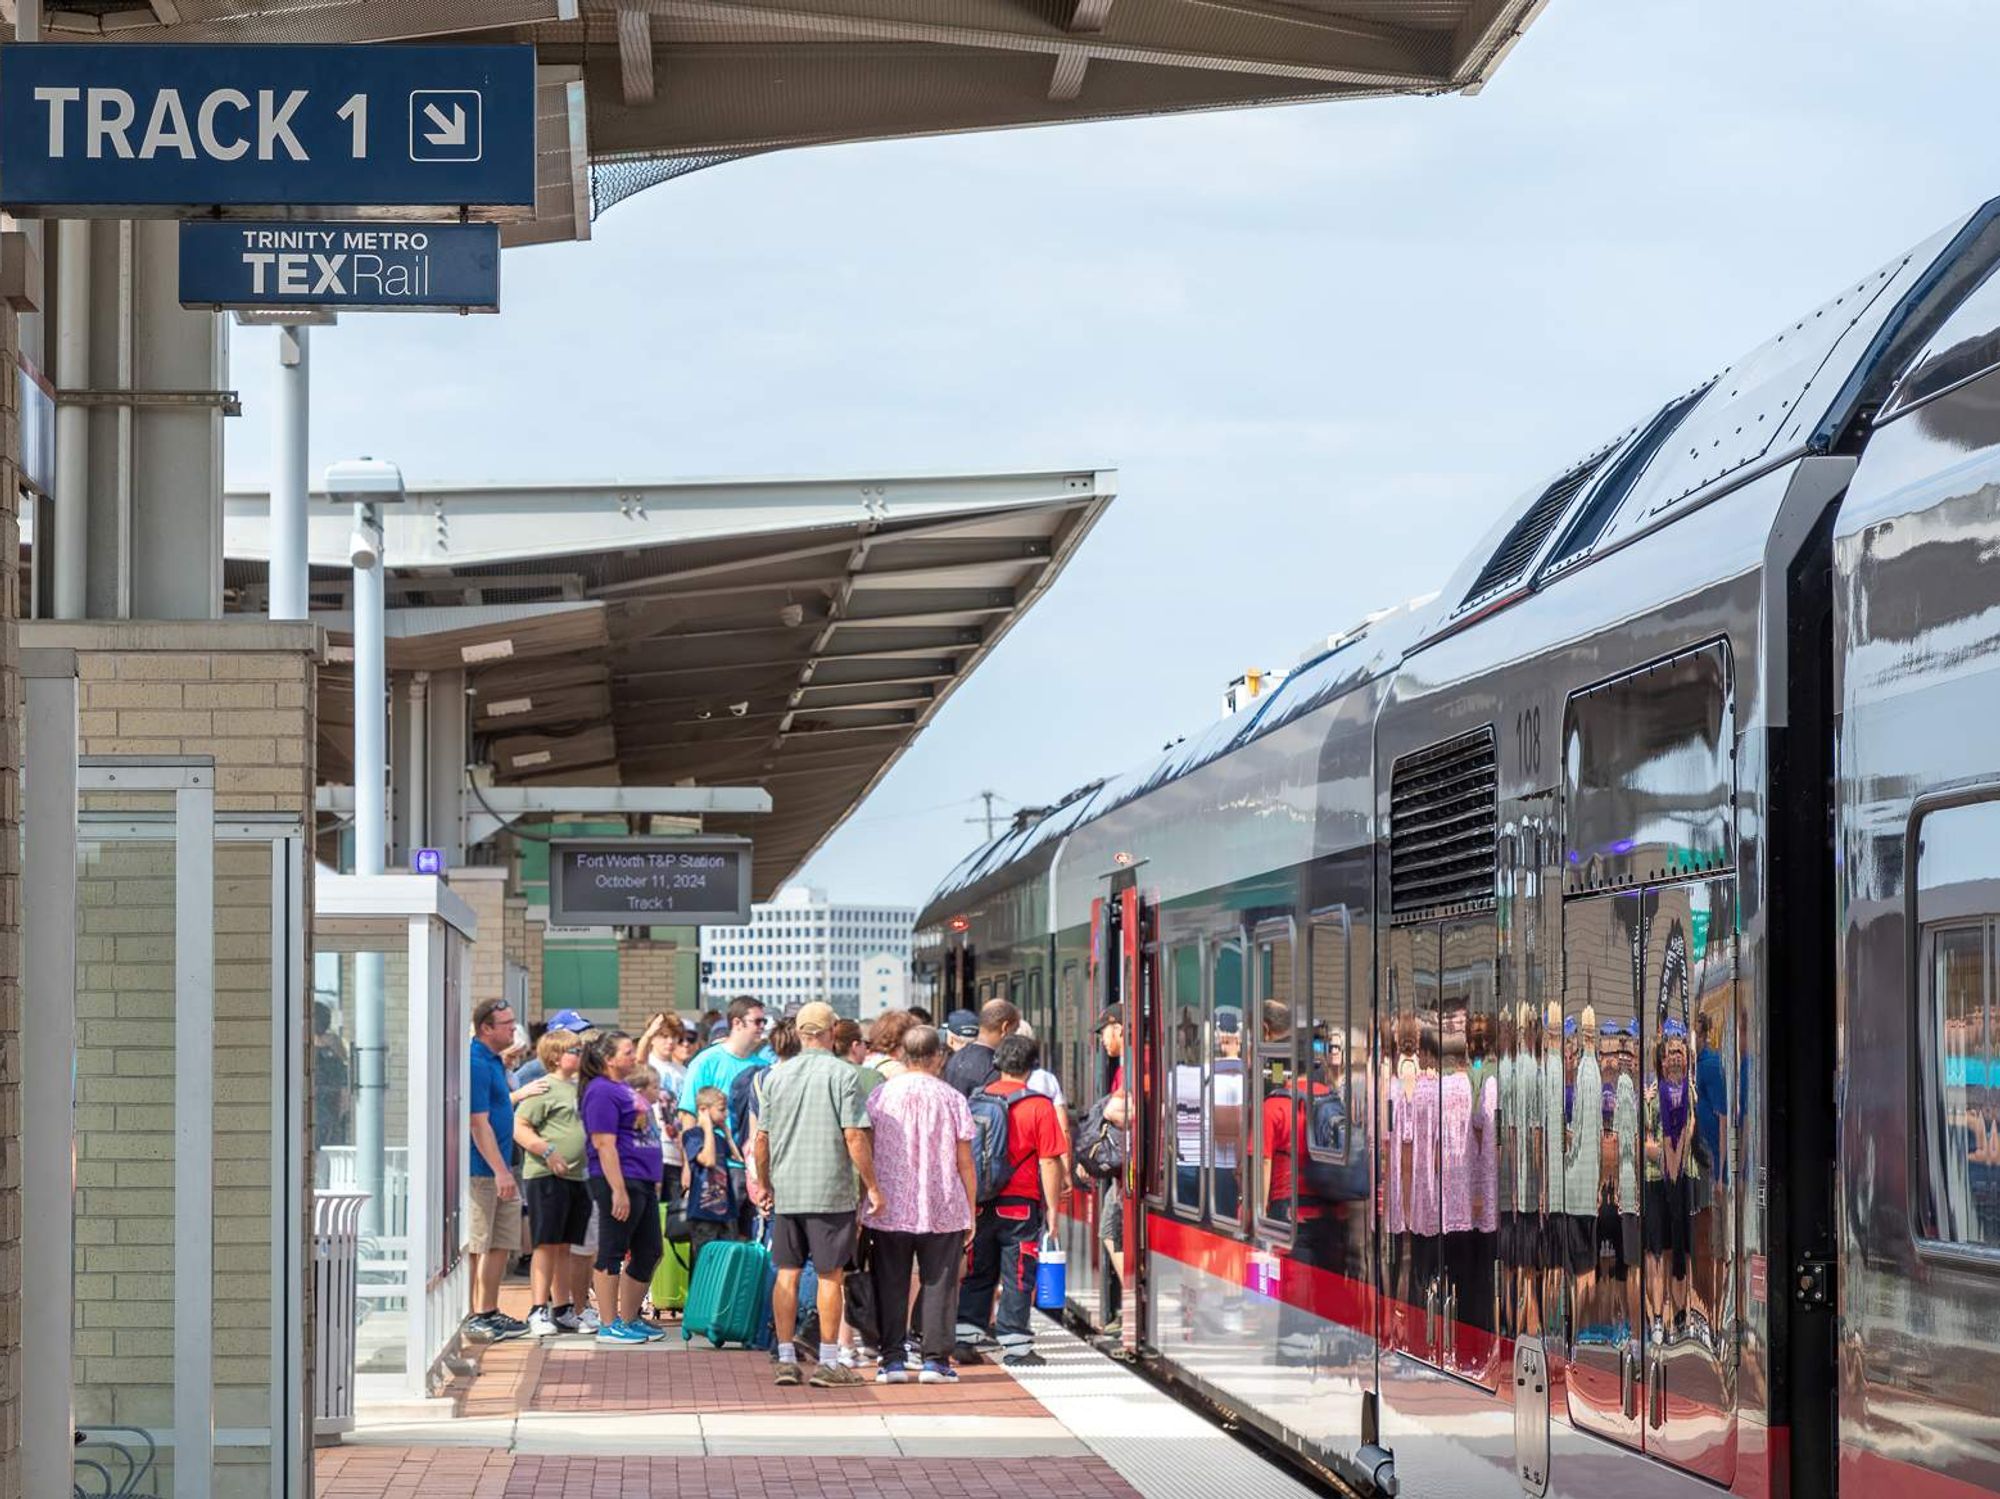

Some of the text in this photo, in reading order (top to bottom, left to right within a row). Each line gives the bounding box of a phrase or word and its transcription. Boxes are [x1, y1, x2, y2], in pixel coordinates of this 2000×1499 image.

[34, 87, 367, 160] TRACK 1
[243, 231, 428, 250] TRINITY METRO
[243, 253, 428, 296] TEXRail
[1516, 705, 1541, 777] 108
[577, 853, 725, 868] Fort Worth T&P Station
[595, 874, 706, 890] October 11, 2024
[626, 895, 673, 910] Track 1
